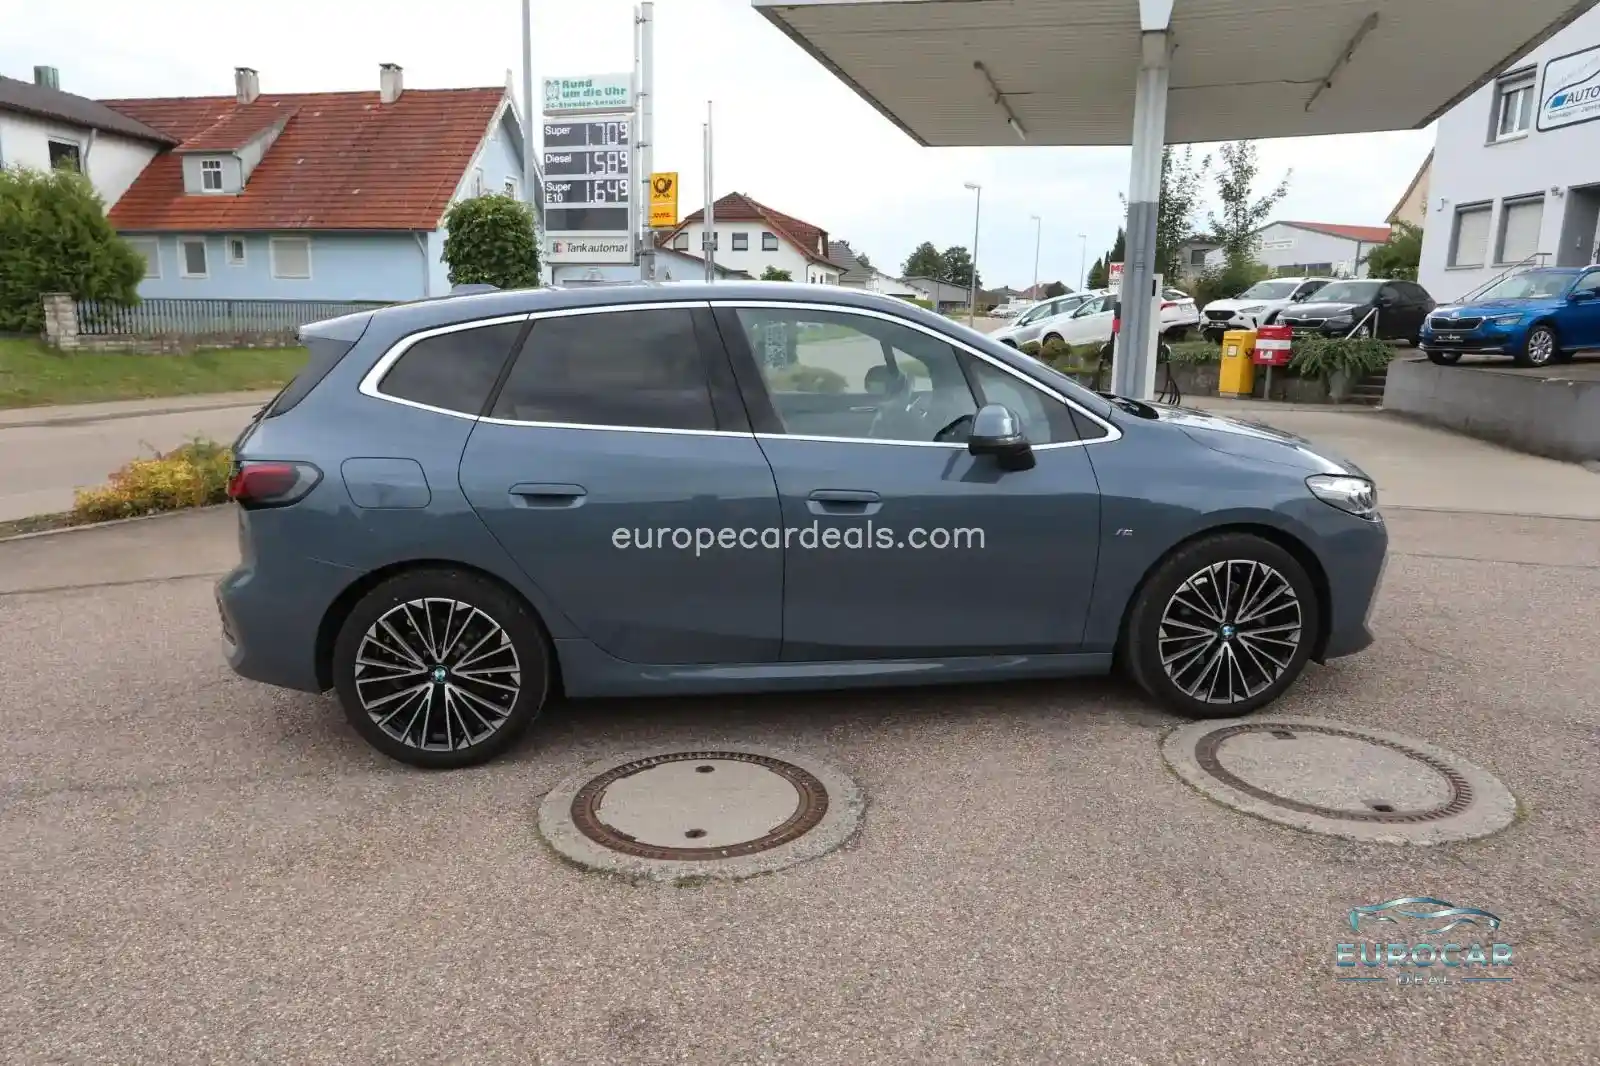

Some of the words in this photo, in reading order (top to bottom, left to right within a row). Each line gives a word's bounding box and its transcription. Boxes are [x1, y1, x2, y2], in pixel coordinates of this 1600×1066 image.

[562, 80, 593, 89] Rund
[562, 90, 581, 98] um
[583, 88, 602, 97] die
[605, 87, 627, 96] Uhr
[544, 125, 571, 137] Super
[545, 153, 572, 164] Diesel
[546, 182, 572, 193] Super
[546, 193, 564, 203] E10
[566, 242, 628, 253] Tankautomat
